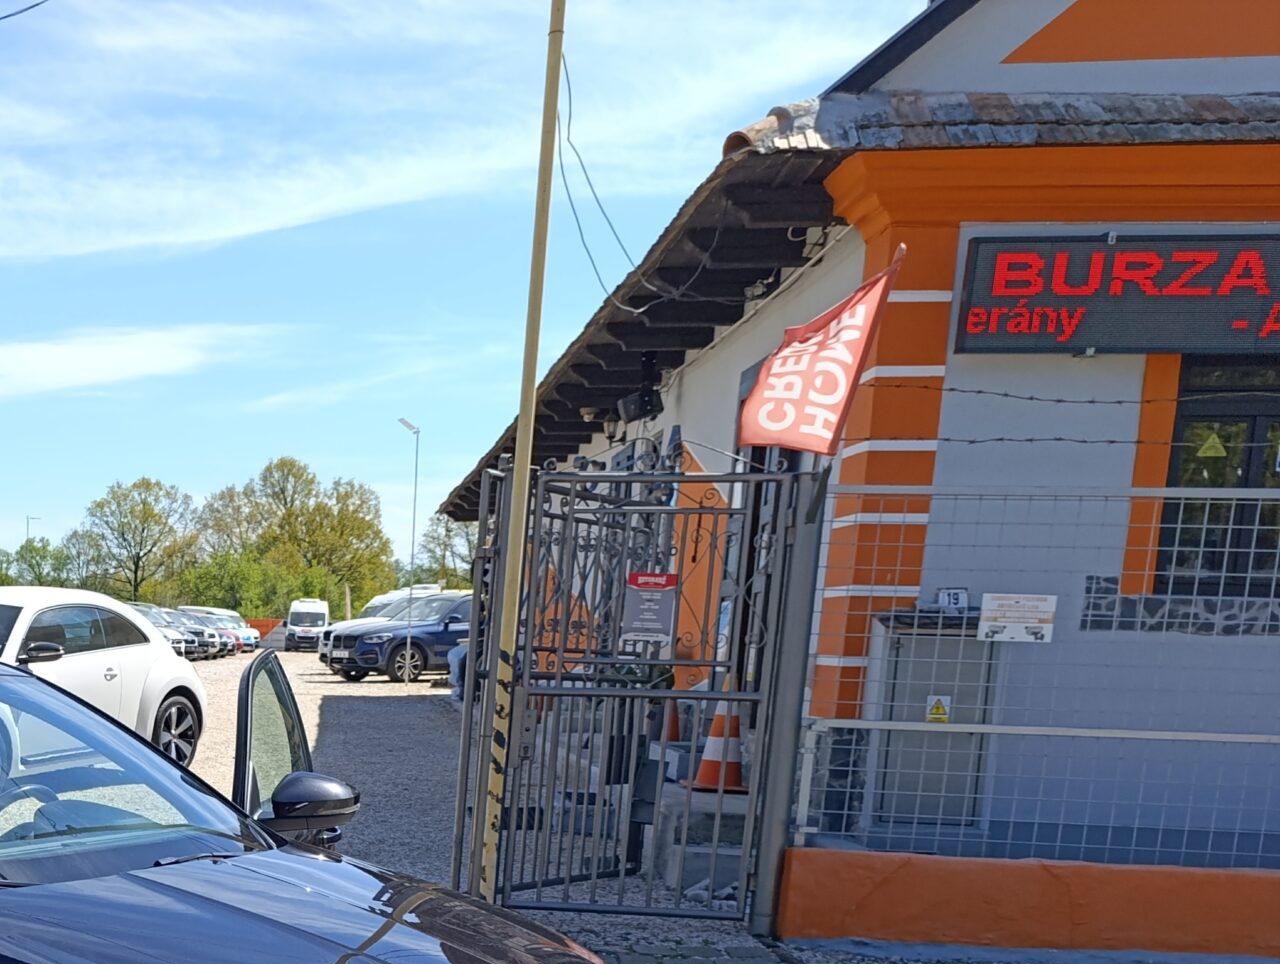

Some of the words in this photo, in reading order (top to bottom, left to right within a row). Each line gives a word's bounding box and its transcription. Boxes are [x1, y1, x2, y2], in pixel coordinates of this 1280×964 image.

[991, 250, 1271, 297] BURZA
[966, 298, 1087, 342] erány
[946, 592, 960, 606] 19
